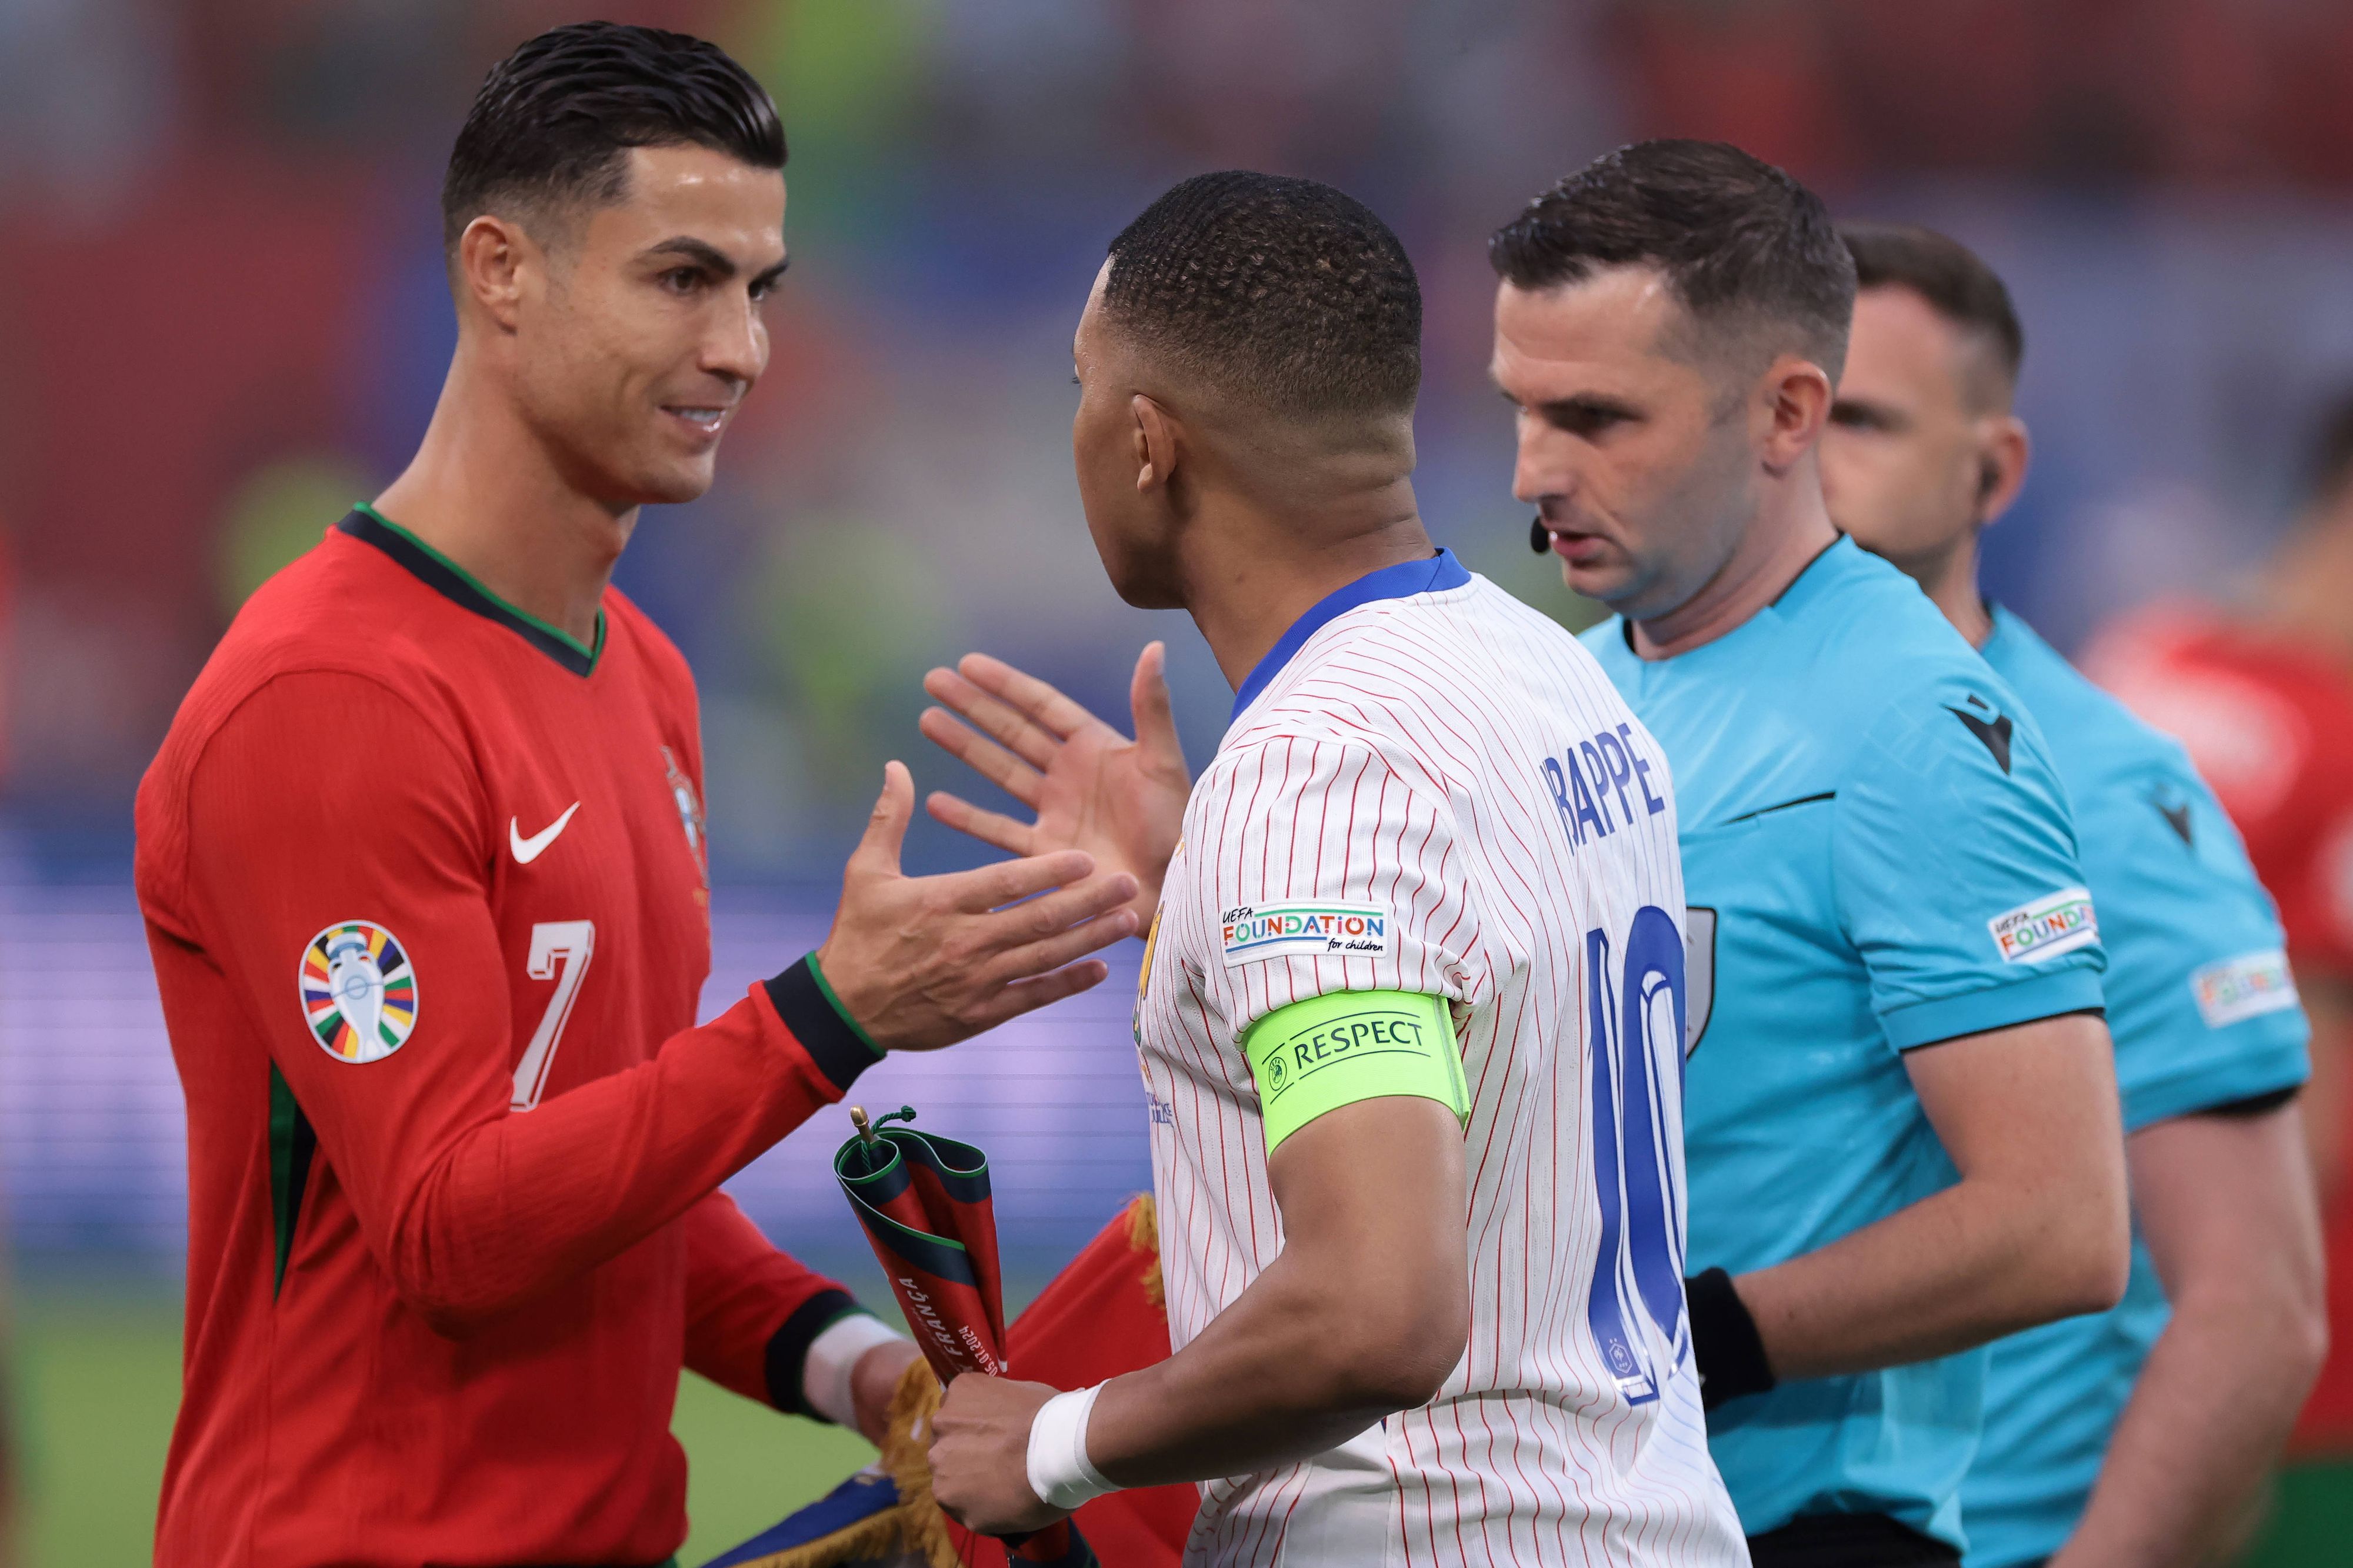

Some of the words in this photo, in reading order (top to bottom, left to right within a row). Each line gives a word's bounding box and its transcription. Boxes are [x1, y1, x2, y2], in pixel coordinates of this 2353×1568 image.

[1223, 907, 1254, 923] UEFA
[1328, 938, 1342, 952] for
[1345, 939, 1384, 951] children
[510, 920, 595, 1112] 7
[1294, 1020, 1422, 1070] RESPECT
[1587, 906, 1688, 1406] 10
[899, 1279, 963, 1356] FRANÇA
[958, 1325, 998, 1377] 05.07.2024
